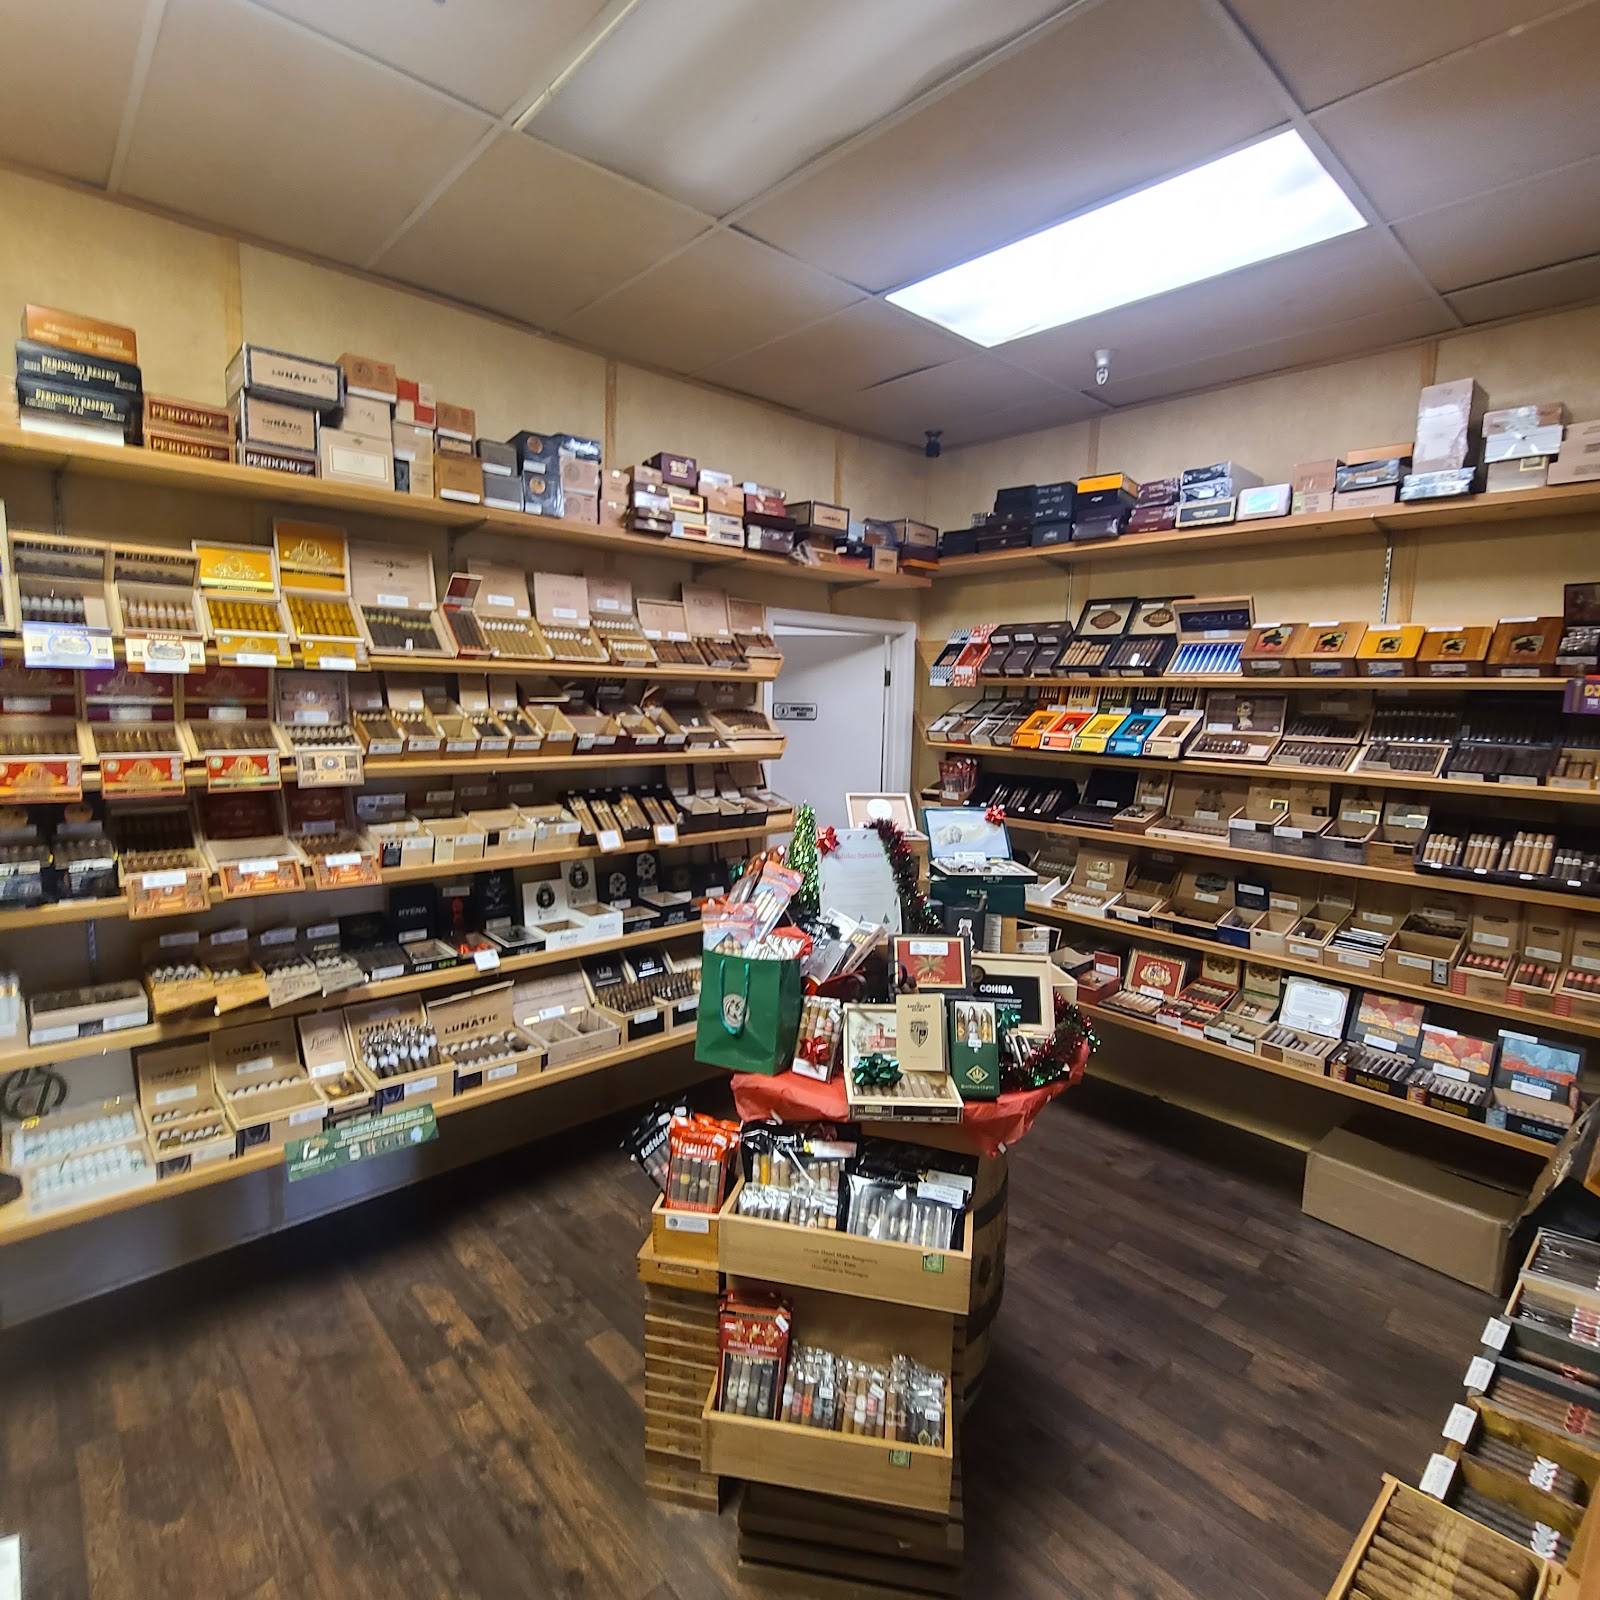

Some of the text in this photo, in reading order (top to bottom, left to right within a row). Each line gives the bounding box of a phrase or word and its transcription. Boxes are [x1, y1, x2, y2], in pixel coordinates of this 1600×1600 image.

[152, 405, 213, 427] PERDOMO
[152, 440, 213, 459] PERDOMO
[246, 453, 301, 474] PERDOMO
[398, 906, 428, 918] HYENA
[979, 984, 1014, 995] COHIBA
[445, 1014, 500, 1036] LUNATIC
[1513, 1074, 1558, 1091] NICA RUSTICA
